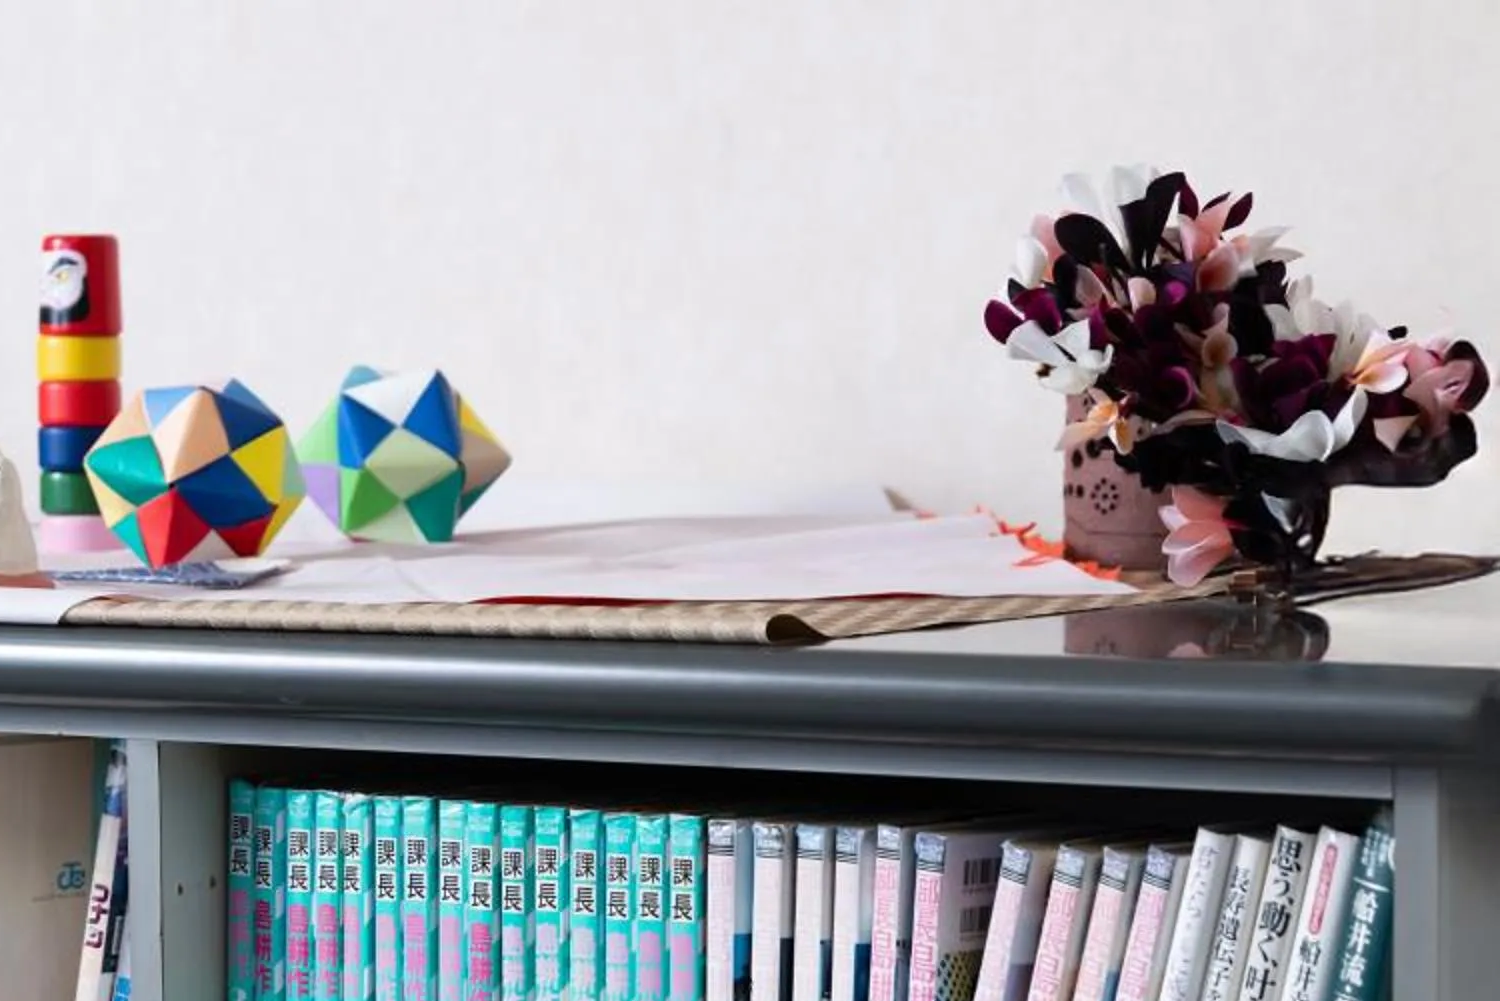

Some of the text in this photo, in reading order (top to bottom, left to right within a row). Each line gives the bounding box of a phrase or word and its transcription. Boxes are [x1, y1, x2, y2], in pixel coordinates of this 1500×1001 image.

[256, 826, 272, 887] 課長
[288, 831, 310, 892] 課長
[316, 831, 338, 892] 課長
[343, 832, 359, 892] 課長
[377, 839, 396, 899] 課長
[406, 839, 427, 900] 課長
[441, 842, 461, 902] 課長
[471, 847, 492, 909] 課長
[503, 849, 524, 911] 課長
[537, 847, 558, 909] 課長
[574, 851, 596, 914] 課長
[607, 857, 628, 918] 課長
[639, 857, 661, 920] 課長
[671, 858, 694, 921] 課長
